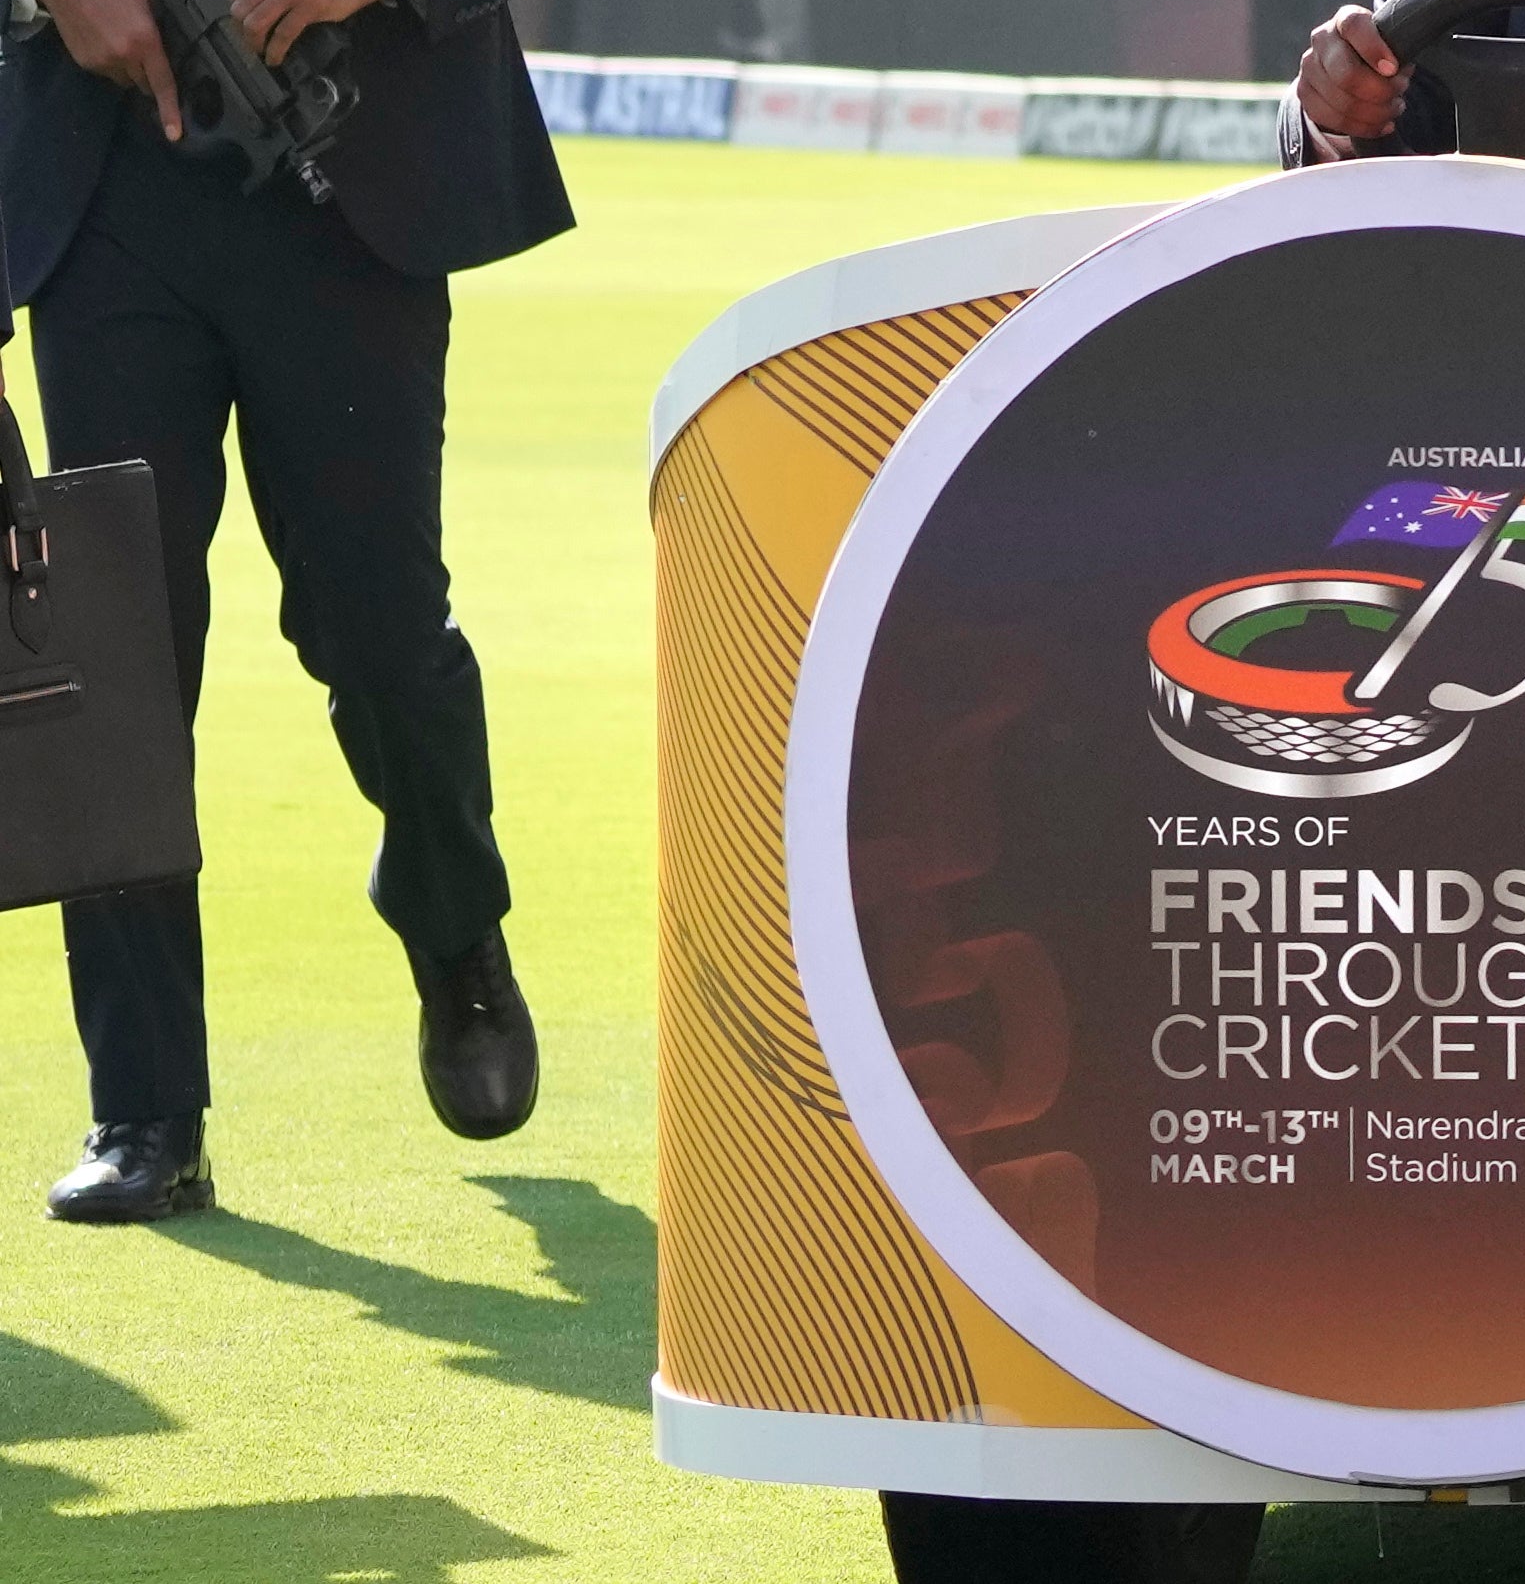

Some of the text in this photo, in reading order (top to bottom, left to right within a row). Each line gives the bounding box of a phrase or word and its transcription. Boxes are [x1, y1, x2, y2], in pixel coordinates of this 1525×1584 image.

[1148, 815, 1350, 847] YEARS OF
[1149, 1153, 1296, 1184] MARCH
[1366, 1152, 1518, 1184] Stadium
